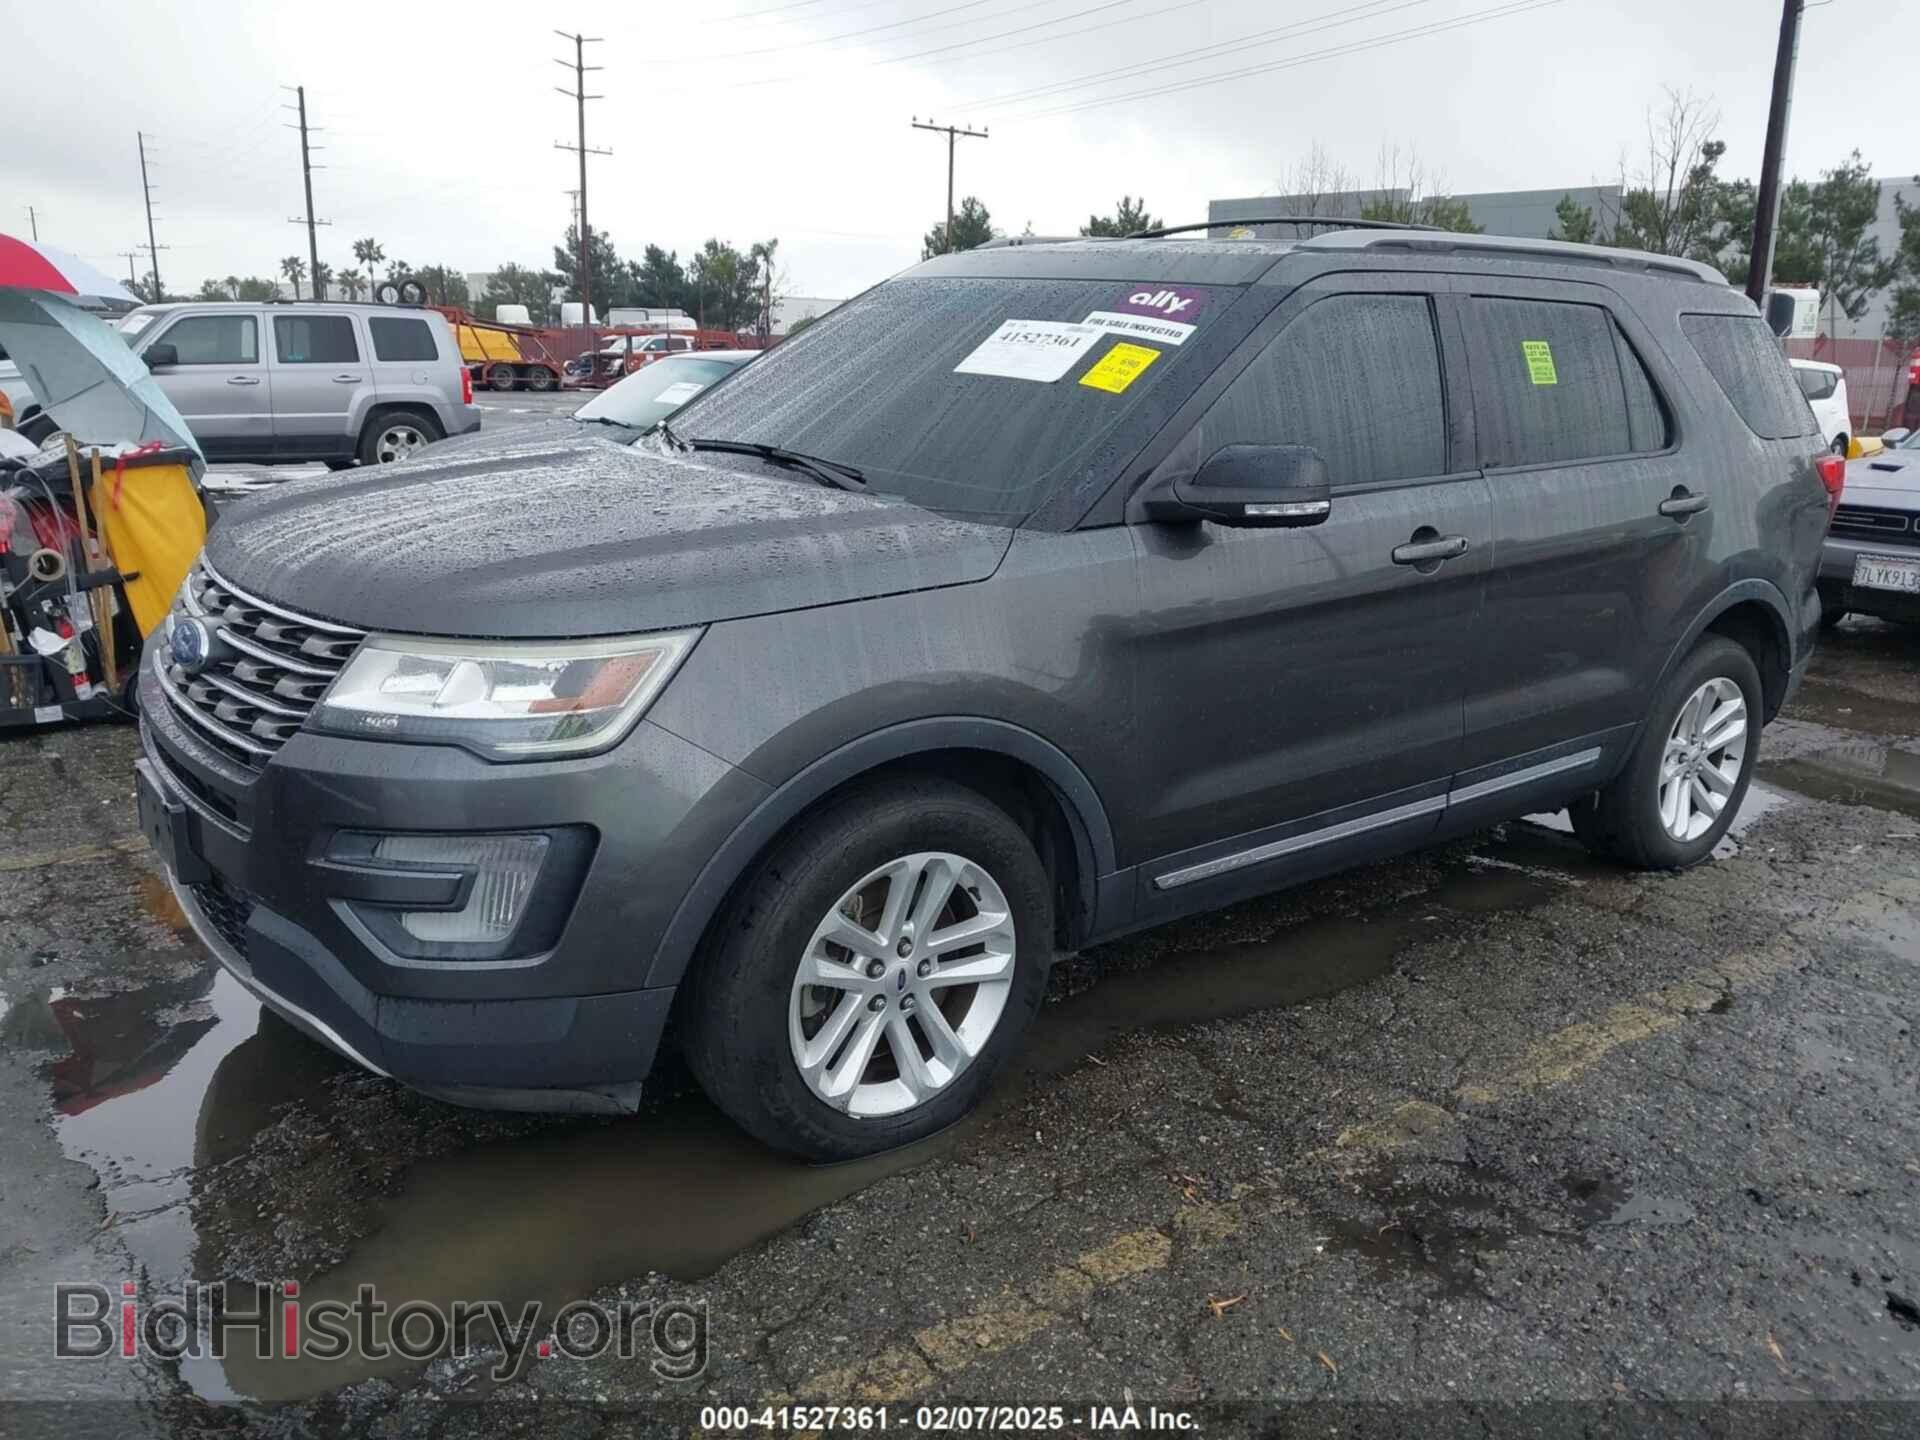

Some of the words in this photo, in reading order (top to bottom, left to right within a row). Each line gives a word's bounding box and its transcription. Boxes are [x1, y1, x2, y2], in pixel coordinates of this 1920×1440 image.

[1129, 290, 1193, 314] ally
[1129, 323, 1183, 337] INSPECTED
[1001, 332, 1081, 347] 41527361
[1862, 566, 1917, 588] 7LYK913
